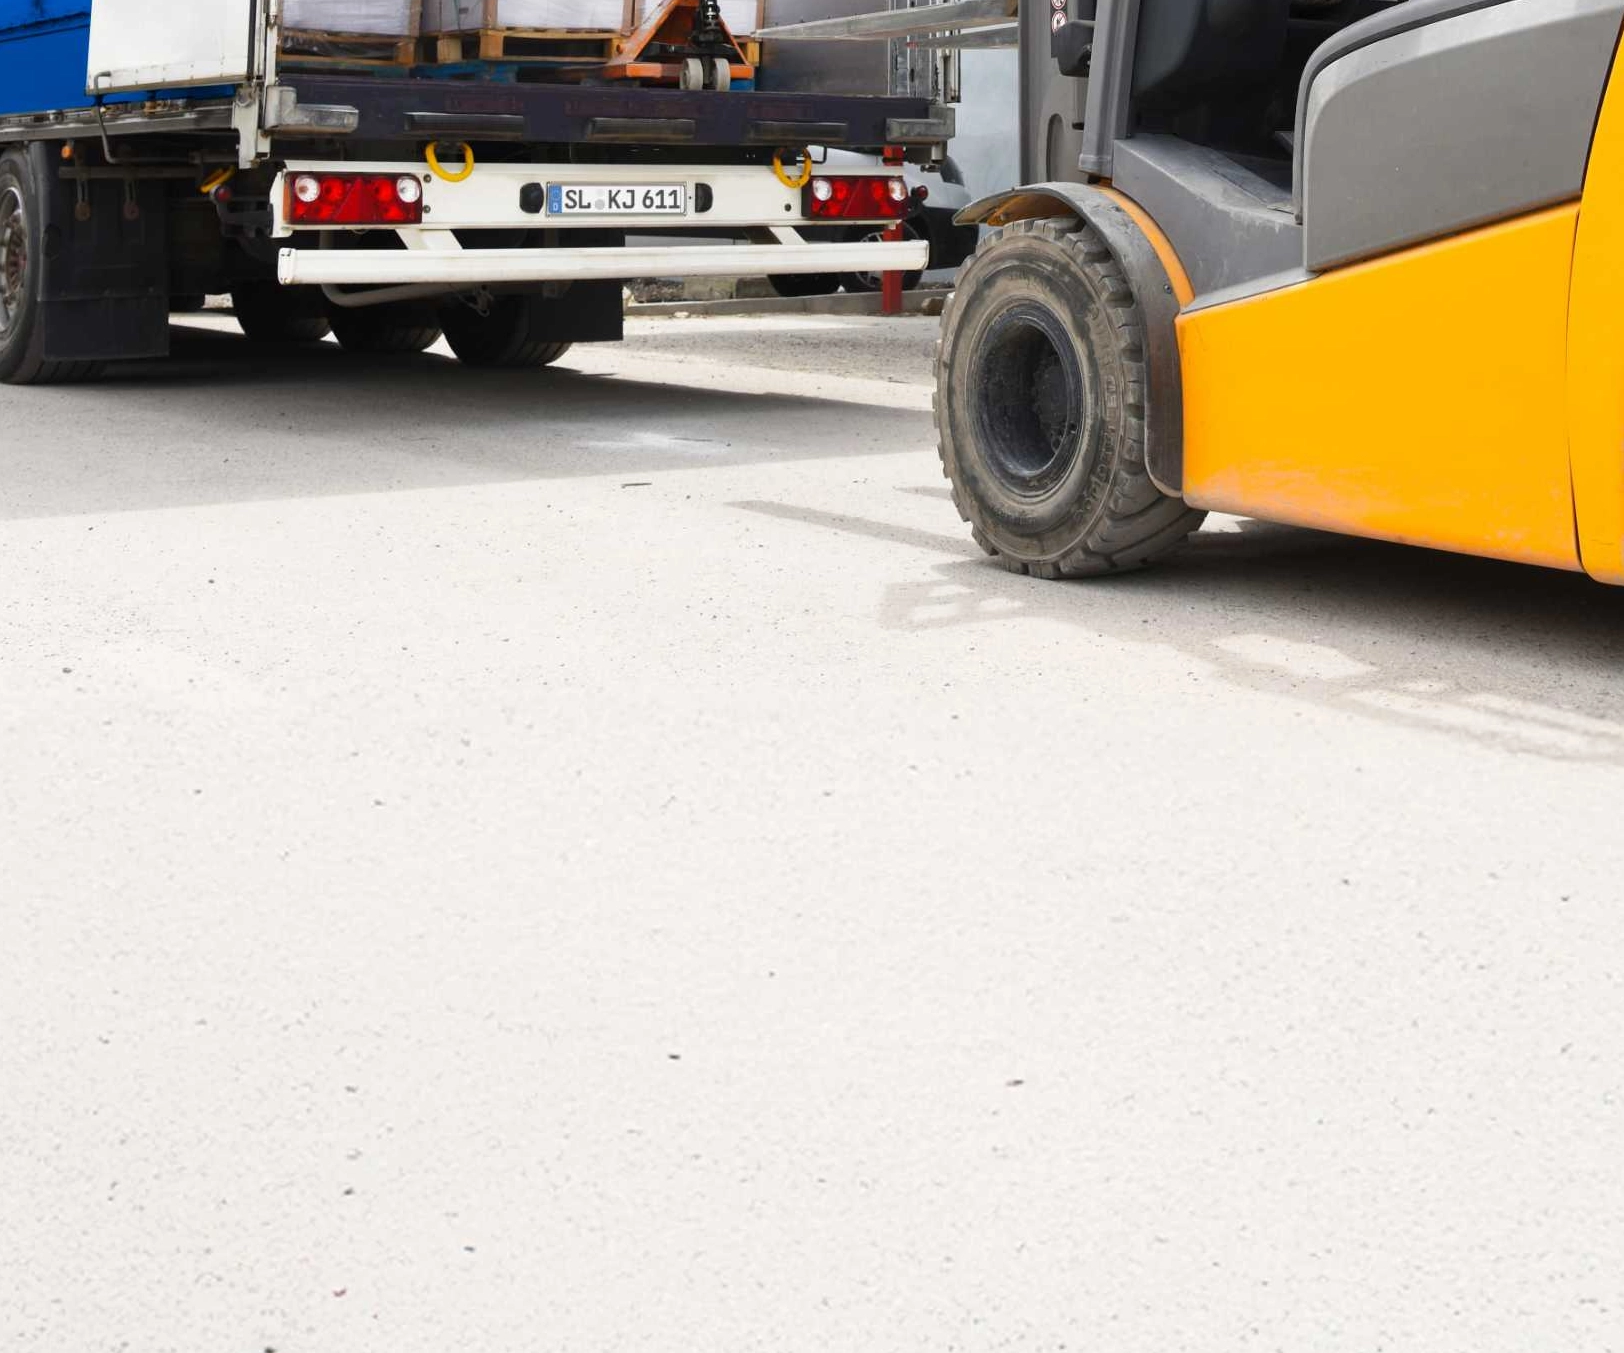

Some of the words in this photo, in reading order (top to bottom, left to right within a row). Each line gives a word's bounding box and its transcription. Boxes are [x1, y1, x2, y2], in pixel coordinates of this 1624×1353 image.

[565, 189, 591, 209] SL
[608, 189, 635, 209] KJ
[642, 189, 680, 209] 611
[552, 202, 559, 212] D
